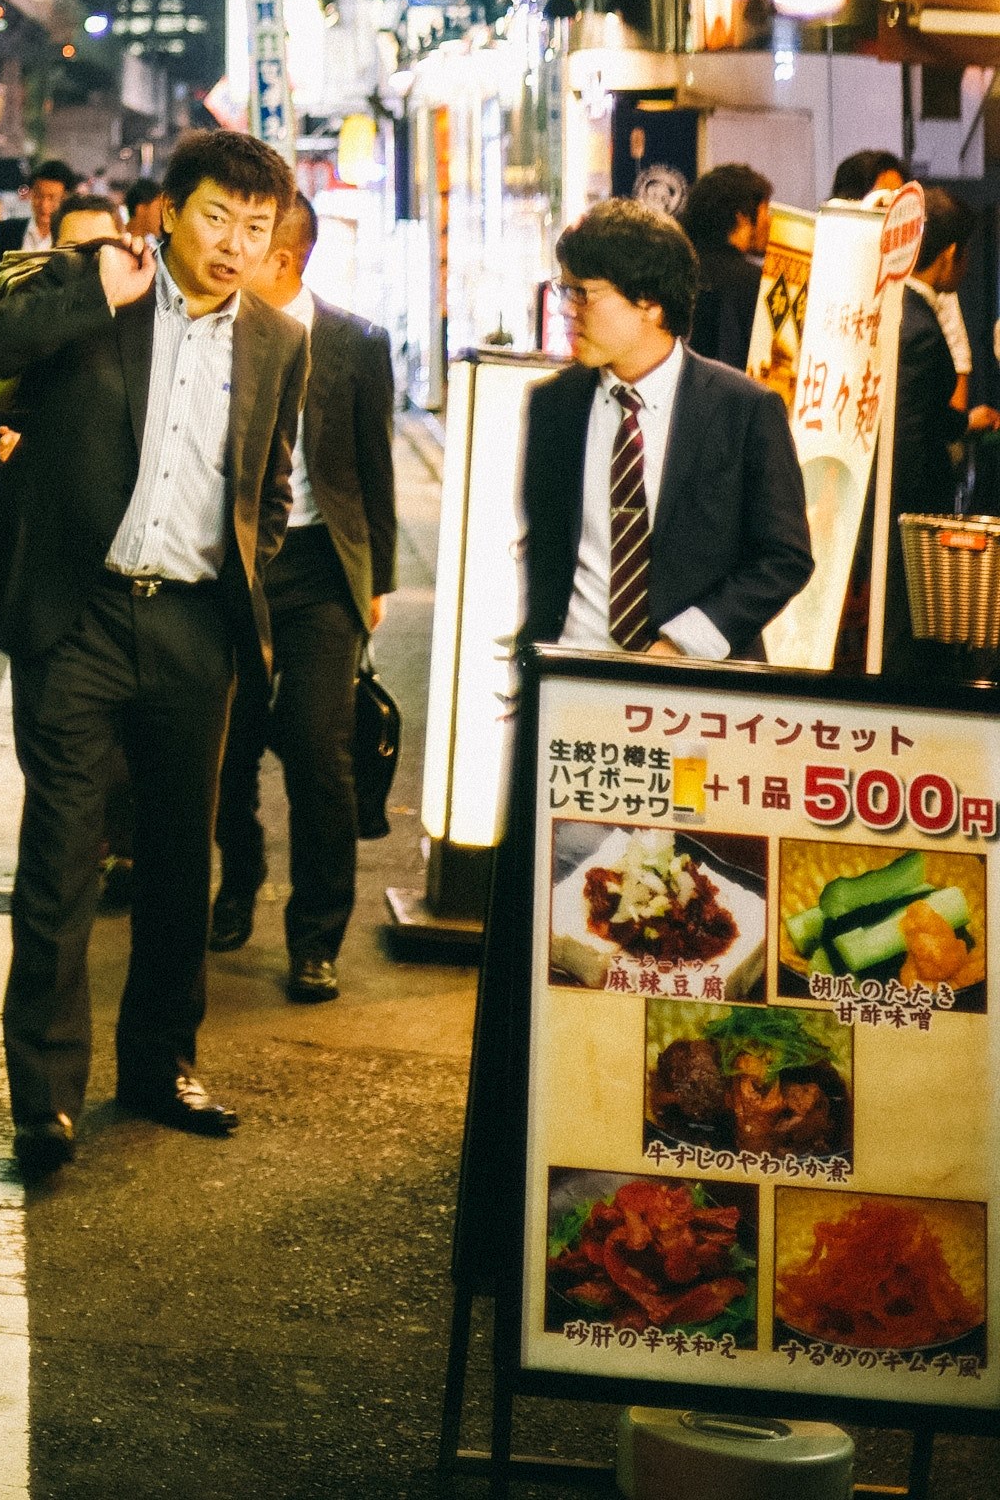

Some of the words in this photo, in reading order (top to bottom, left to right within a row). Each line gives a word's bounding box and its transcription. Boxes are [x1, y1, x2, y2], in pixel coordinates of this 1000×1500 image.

[624, 704, 915, 756] ワンコインセット
[549, 739, 671, 770] 生絞り樽生
[549, 764, 671, 793] ハイボール
[549, 788, 695, 818] レモンサワー
[804, 764, 995, 834] 500円
[607, 967, 724, 1001] 麻辣豆腐
[811, 973, 954, 1006] 胡瓜のたたき
[835, 1001, 932, 1031] 甘酢味噌
[648, 1141, 850, 1183] 牛すじのやわらか煮
[564, 1321, 738, 1360] 砂肝の辛味和え
[780, 1341, 982, 1380] するめのキムチ風
